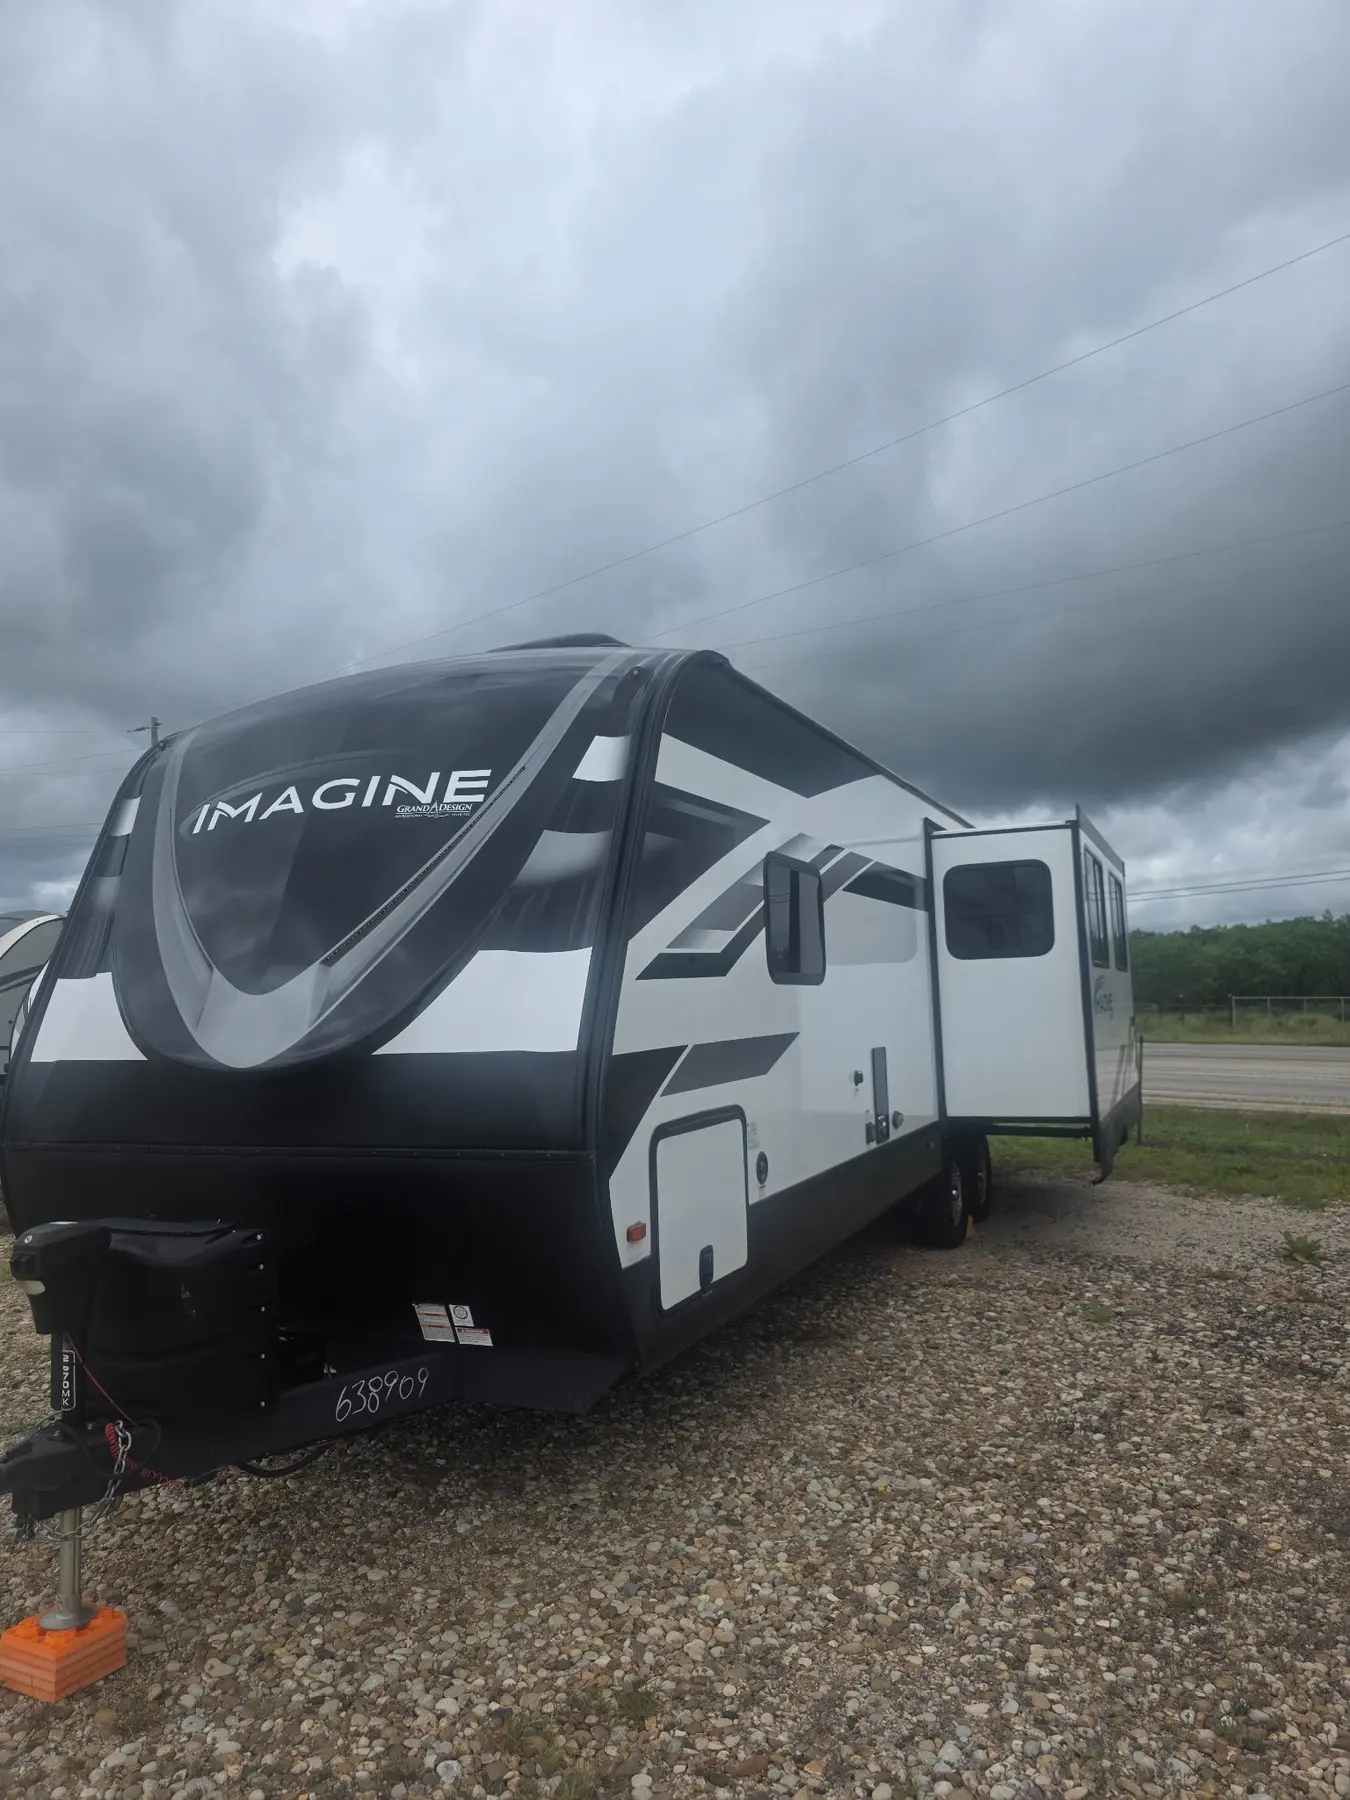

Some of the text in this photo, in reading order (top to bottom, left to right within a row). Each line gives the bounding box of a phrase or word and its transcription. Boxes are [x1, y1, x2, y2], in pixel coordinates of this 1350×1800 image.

[192, 769, 492, 834] IMAGINE
[396, 803, 473, 813] GRAND DESIGN
[335, 1367, 429, 1422] 638909
